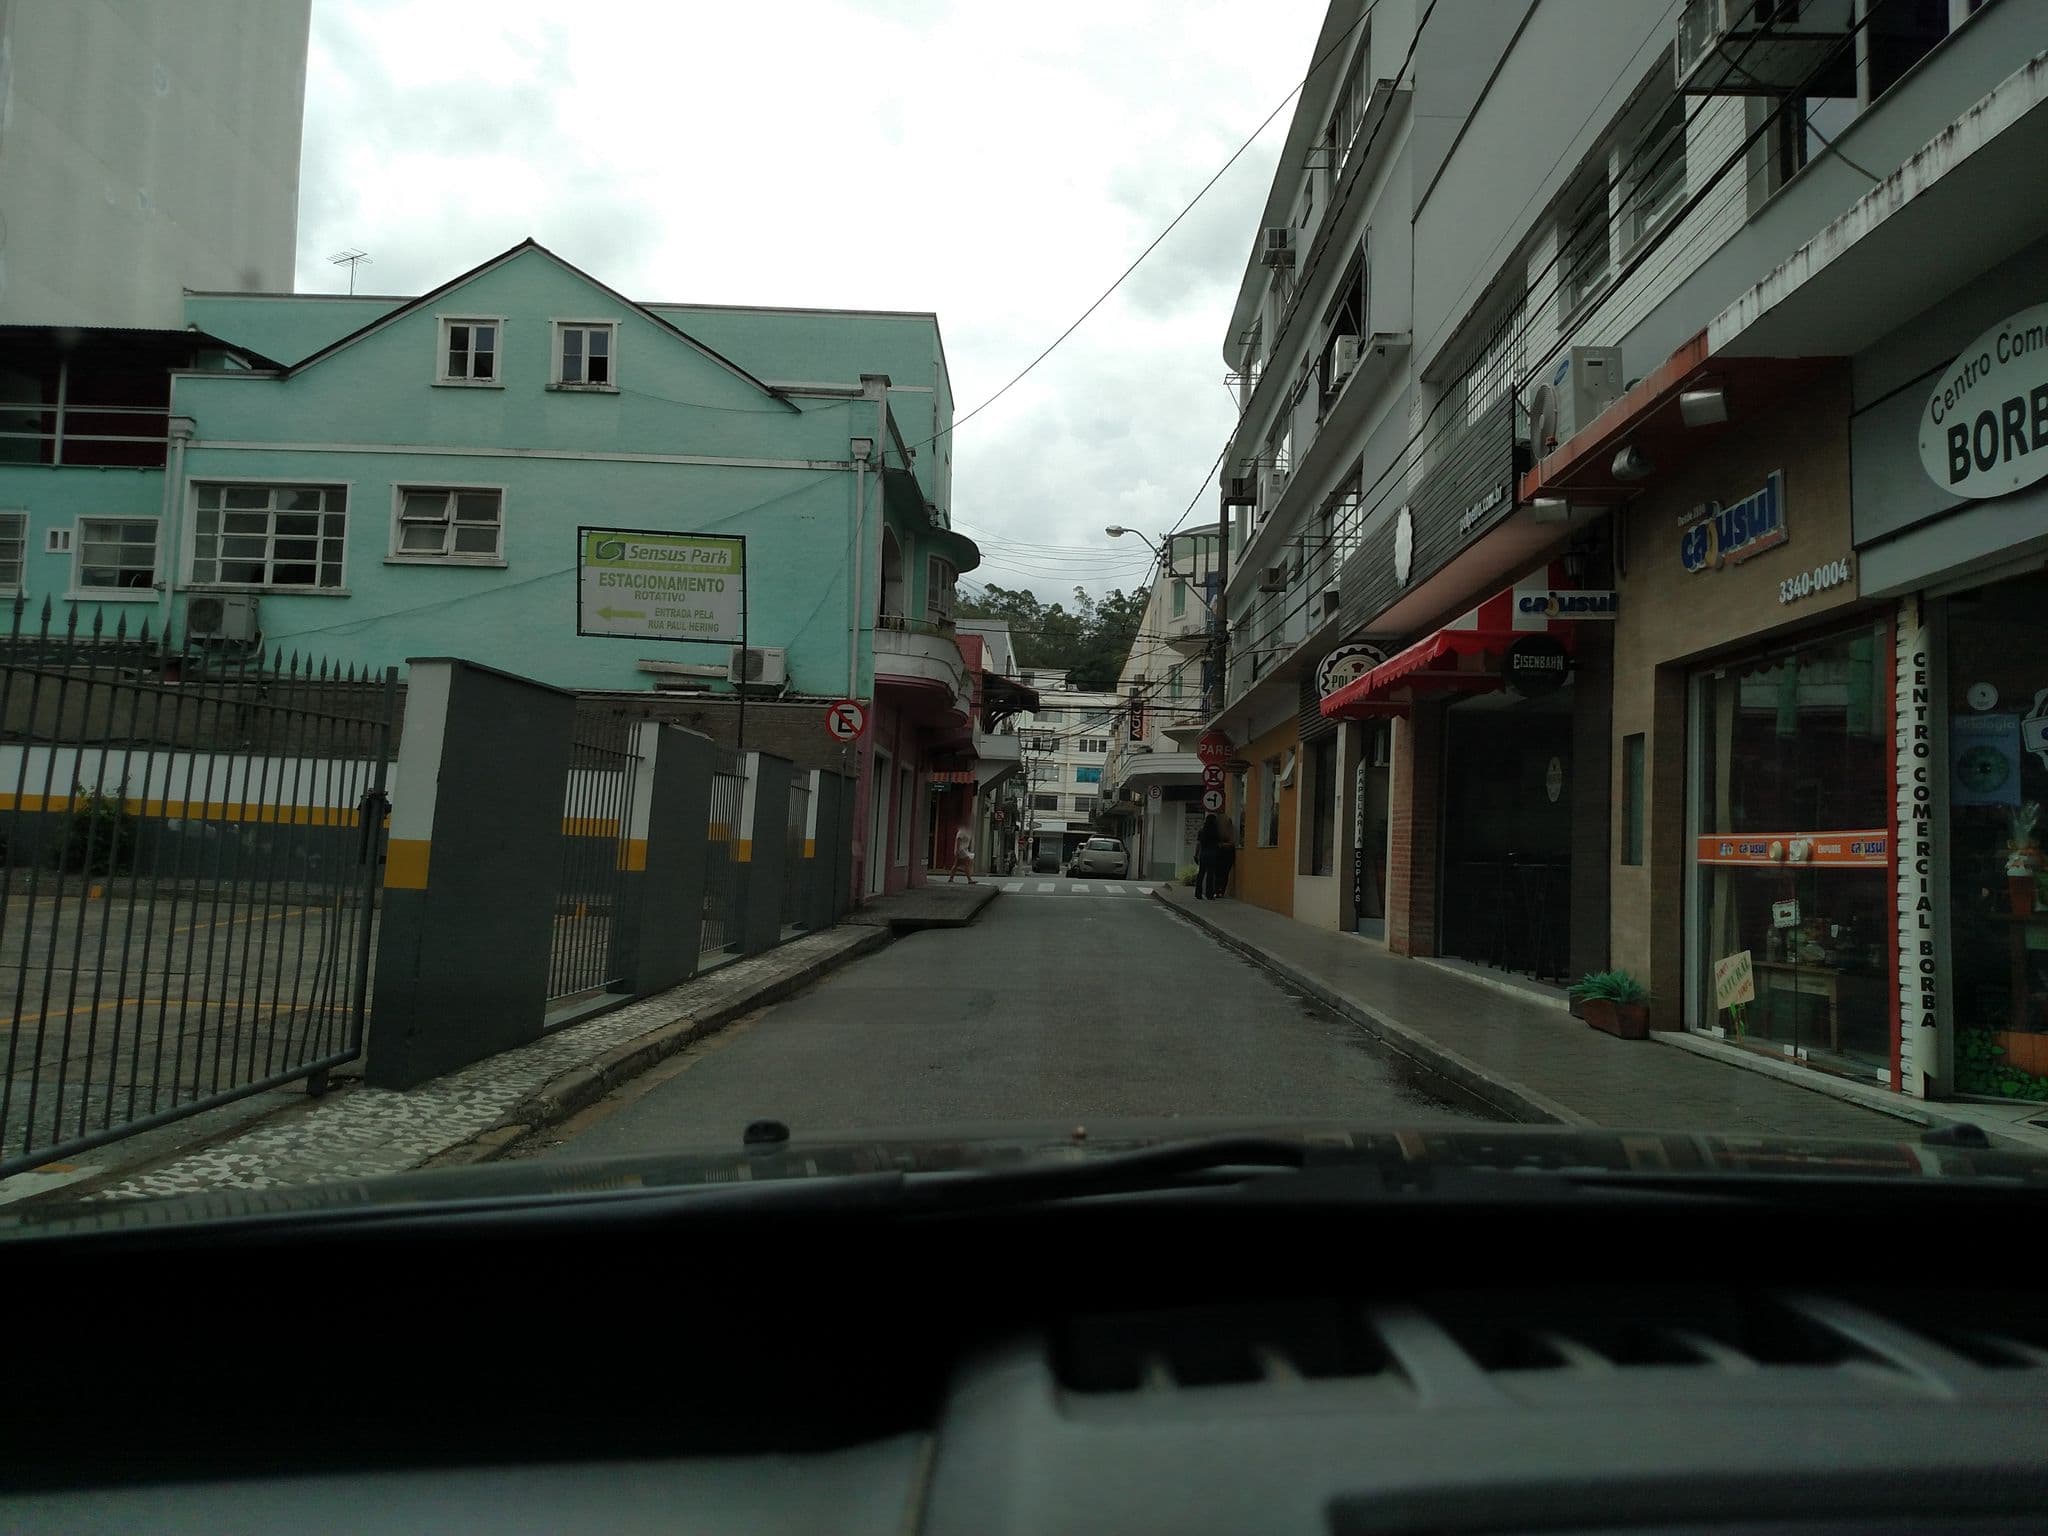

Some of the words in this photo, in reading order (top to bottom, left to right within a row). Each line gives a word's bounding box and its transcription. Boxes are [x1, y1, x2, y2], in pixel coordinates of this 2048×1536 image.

[1931, 353, 1991, 425] Centro
[1997, 325, 2048, 364] Com
[629, 545, 686, 562] Sensus
[691, 549, 728, 565] Park
[599, 573, 725, 593] ESTACIONAMENTO
[1779, 558, 1849, 603] 3340-0004
[635, 591, 686, 603] ROTATIVO
[648, 620, 665, 630] RUA
[667, 620, 687, 631] PAUL
[689, 622, 720, 633] HERING
[655, 607, 692, 619] ENTRADA
[694, 609, 714, 620] PELA
[1513, 654, 1564, 671] EISENBAHN
[1912, 652, 1930, 758] CENTRO
[1200, 744, 1233, 757] PARE
[1356, 769, 1365, 844] PAPELARIA
[1912, 766, 1932, 929] COMERCIAL
[1354, 851, 1362, 903] COPIAS
[1919, 941, 1936, 1028] BORBA
